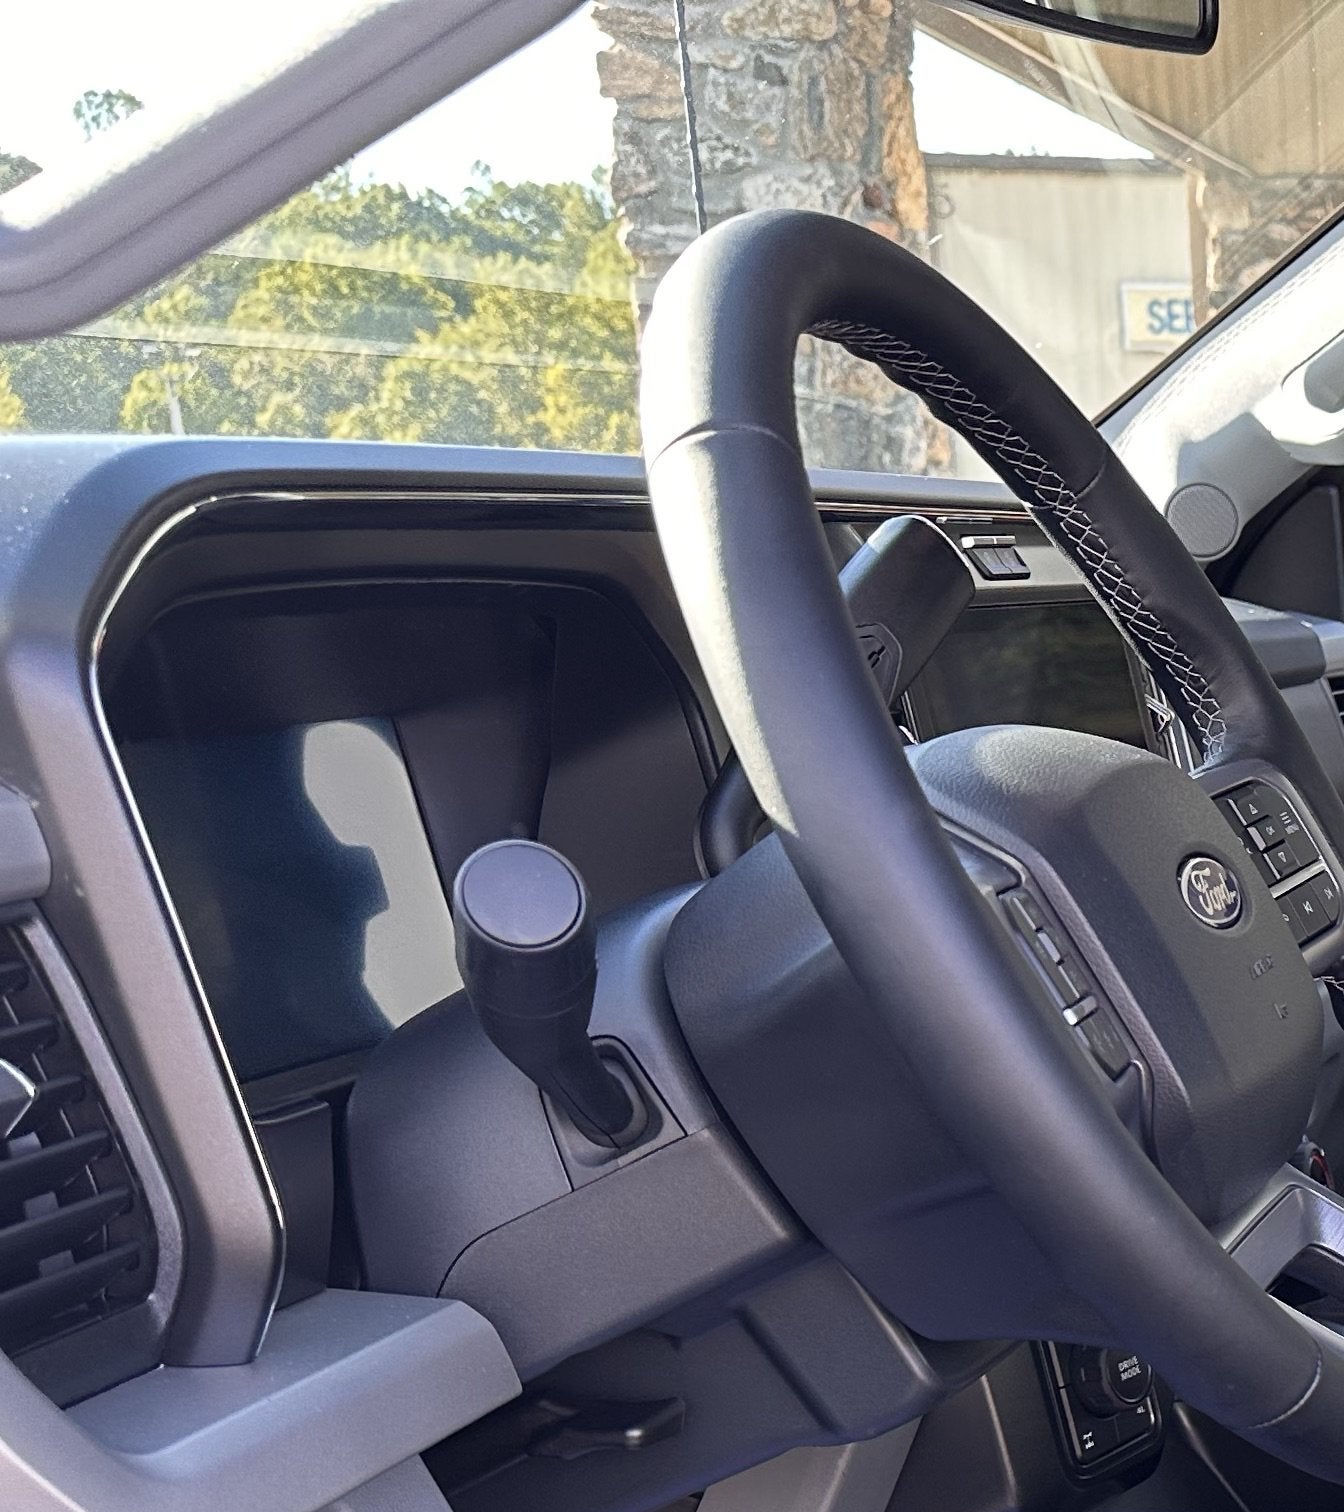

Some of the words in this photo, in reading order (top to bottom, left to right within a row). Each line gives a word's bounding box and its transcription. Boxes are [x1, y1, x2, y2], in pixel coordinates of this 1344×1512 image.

[1190, 867, 1238, 916] Ford
[1118, 1355, 1138, 1372] DRIVE
[1121, 1364, 1141, 1381] MODE
